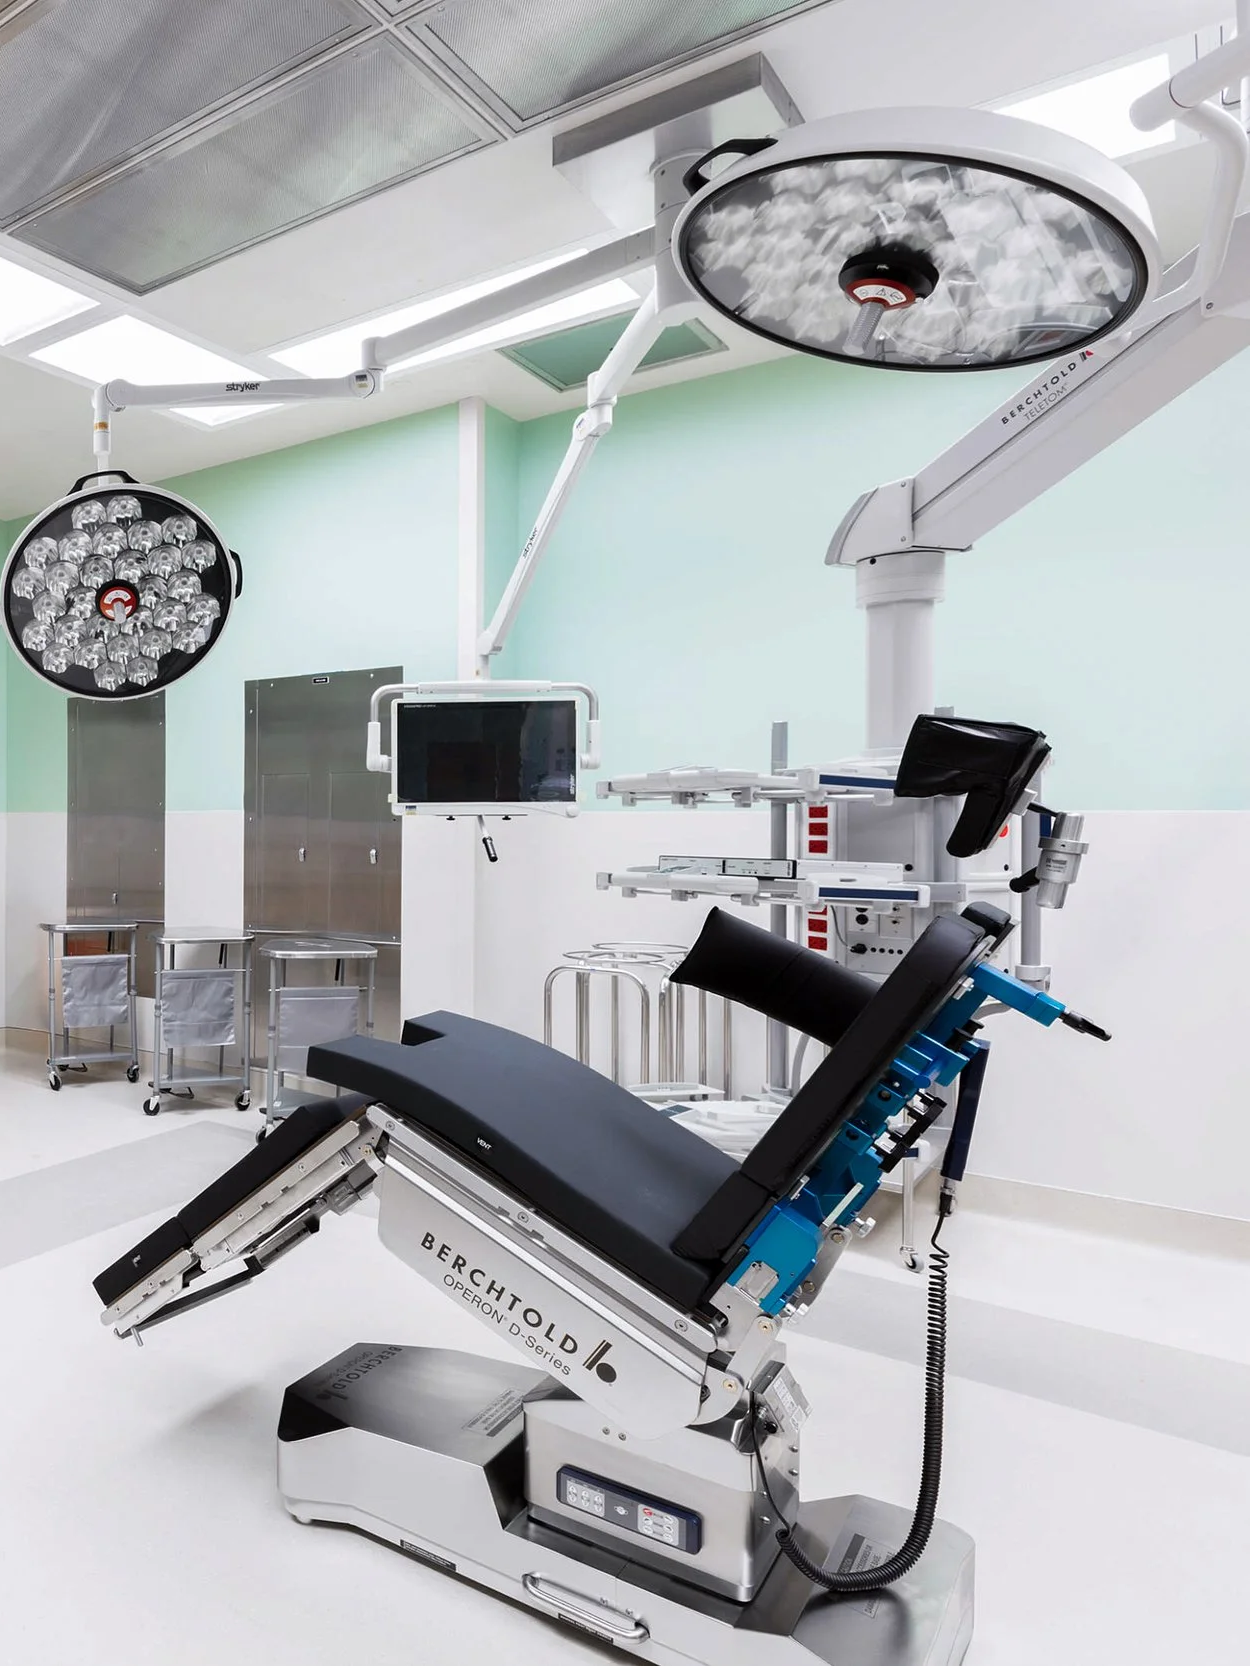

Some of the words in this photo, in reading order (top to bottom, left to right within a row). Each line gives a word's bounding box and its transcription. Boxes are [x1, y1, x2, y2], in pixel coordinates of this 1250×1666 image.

[225, 381, 261, 392] stryker
[1001, 362, 1077, 425] BERCHTOLD
[420, 1232, 579, 1355] BERCHTOLD
[332, 1346, 403, 1390] BERCHTOLD
[508, 1322, 572, 1376] D-Series
